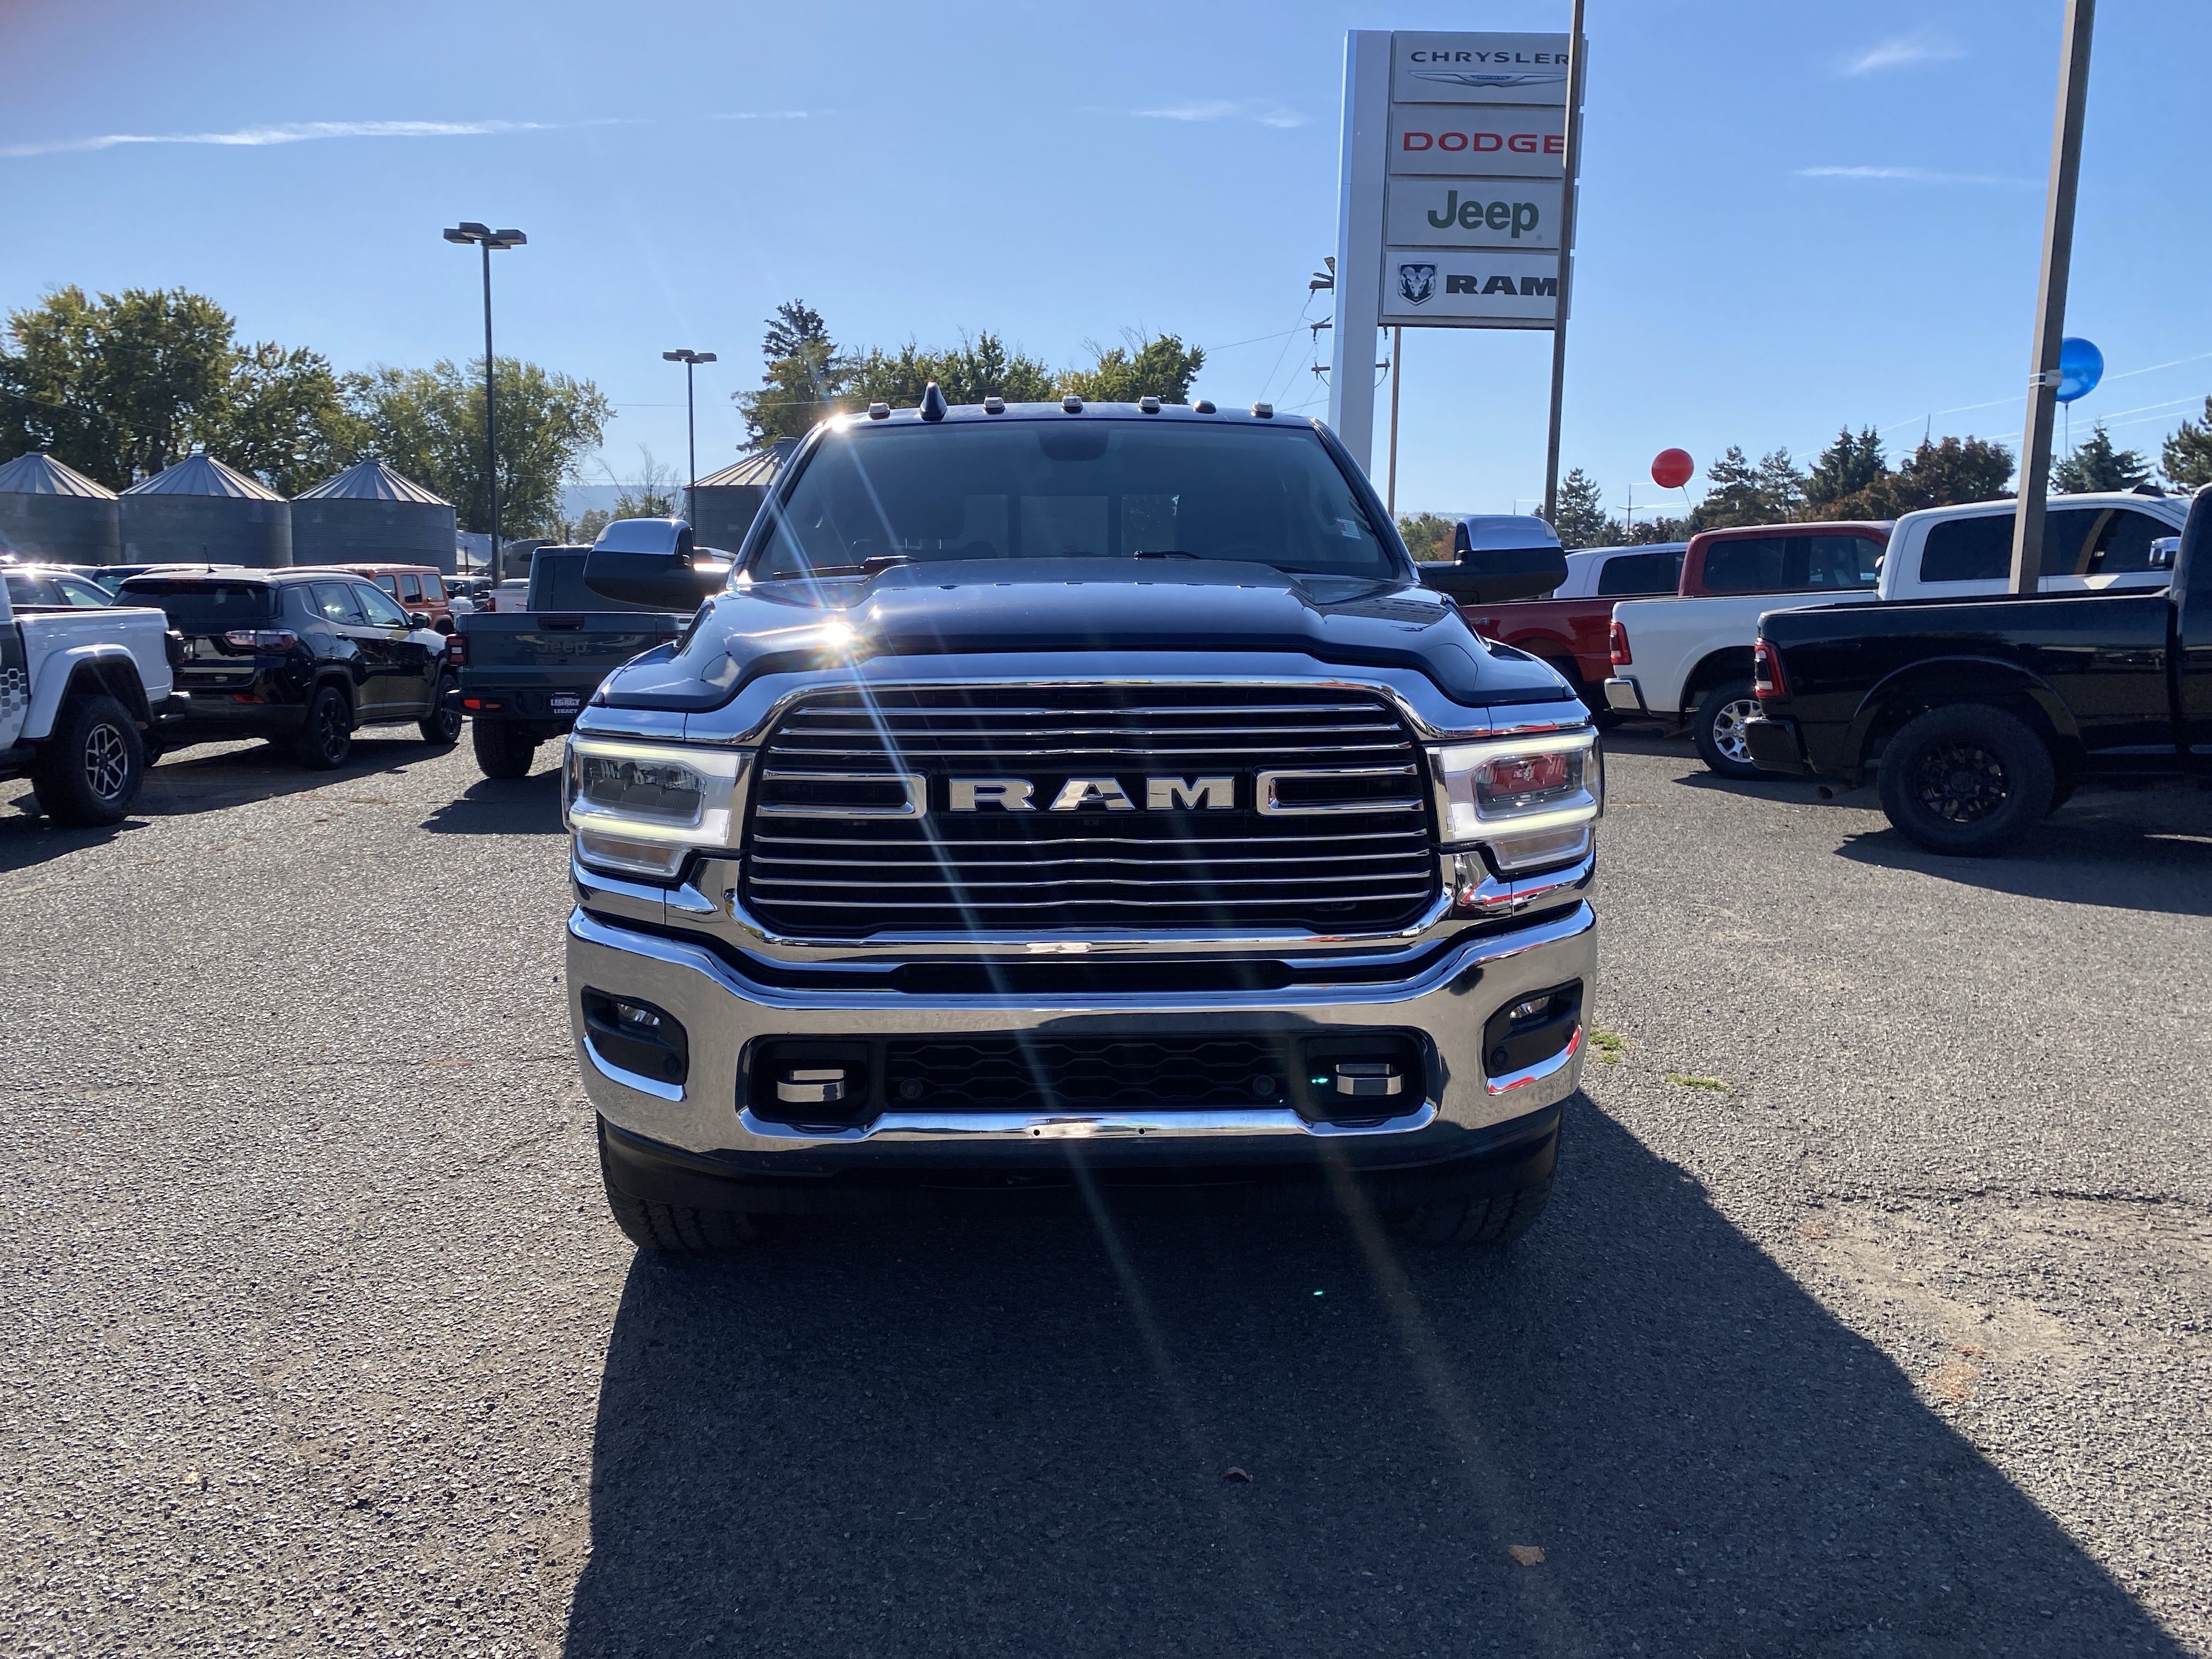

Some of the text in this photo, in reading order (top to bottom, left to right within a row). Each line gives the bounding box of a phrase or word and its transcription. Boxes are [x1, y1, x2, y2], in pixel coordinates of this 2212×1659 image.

[1410, 52, 1568, 65] CHRYSLER
[1403, 132, 1564, 154] DODGE
[1427, 190, 1539, 238] Jeep
[1446, 275, 1557, 296] RAM
[535, 637, 588, 657] Jeep
[949, 777, 1235, 811] RAM
